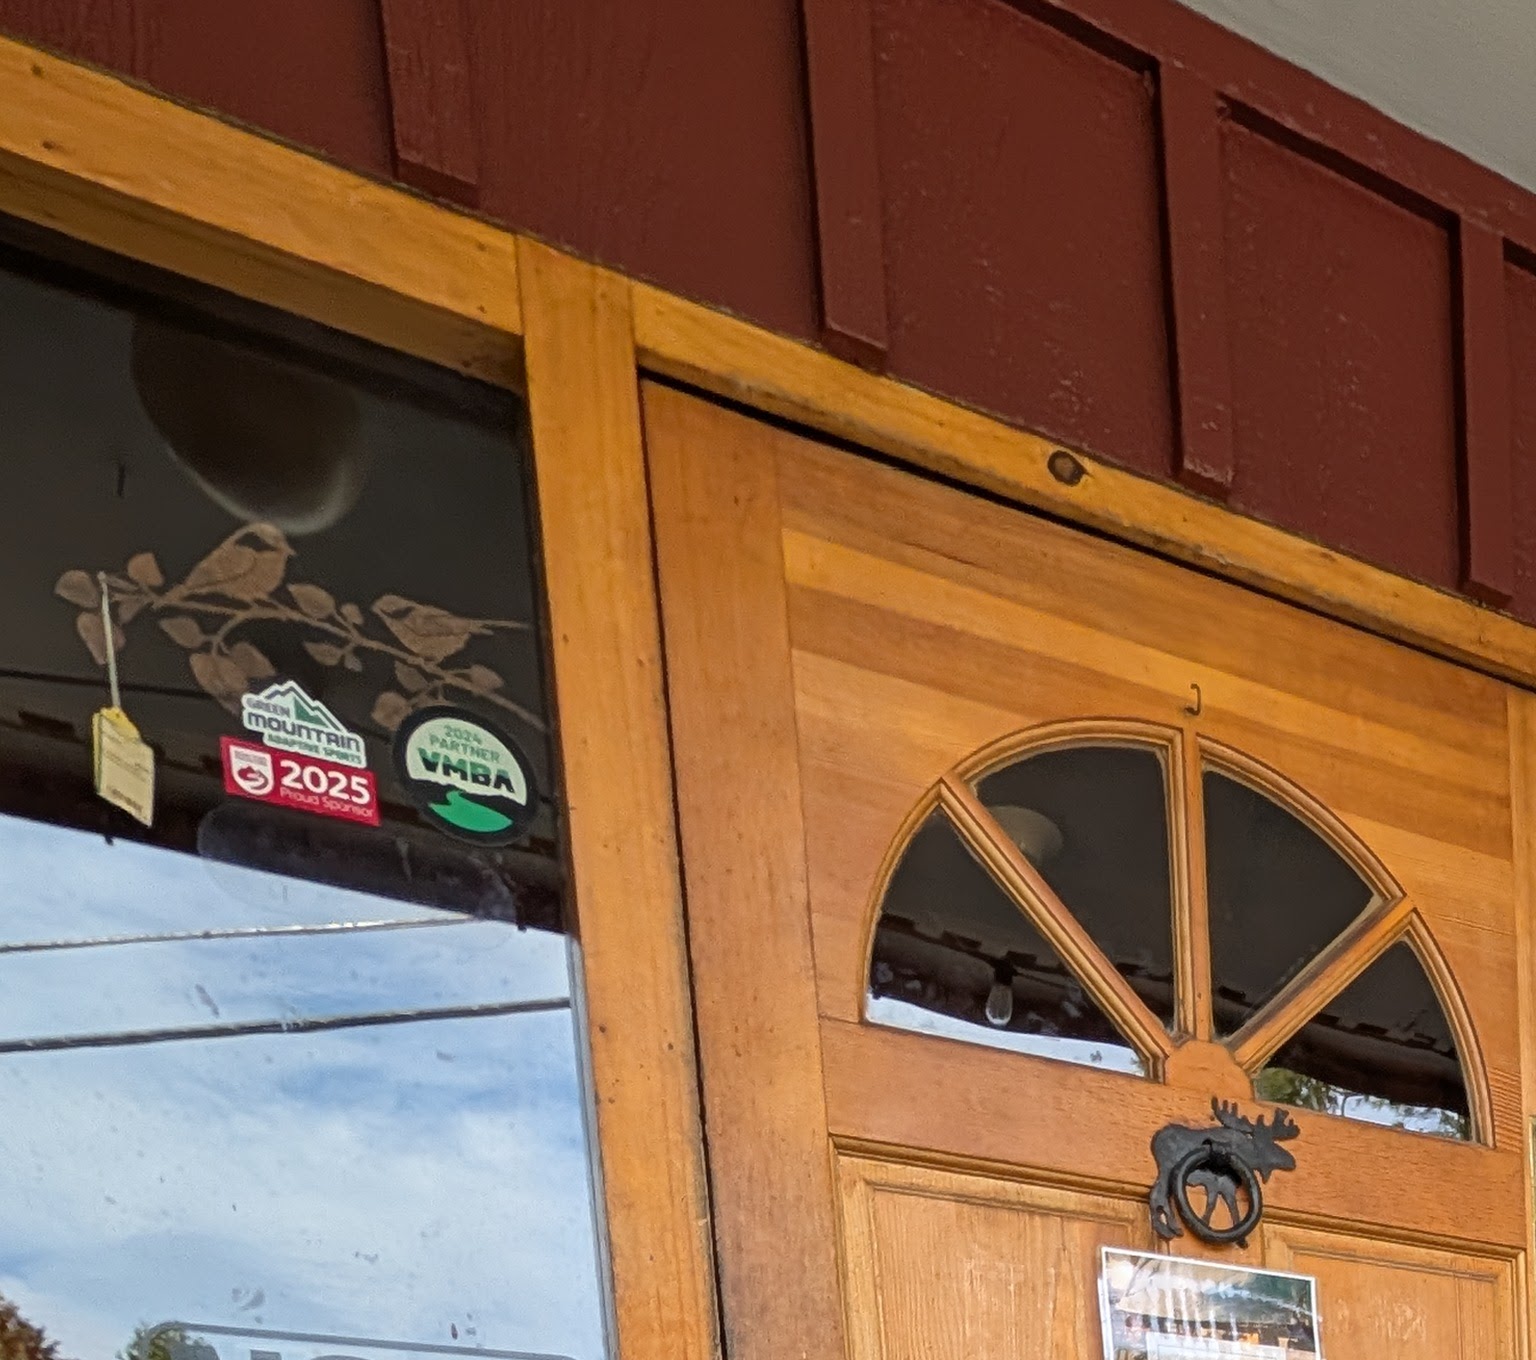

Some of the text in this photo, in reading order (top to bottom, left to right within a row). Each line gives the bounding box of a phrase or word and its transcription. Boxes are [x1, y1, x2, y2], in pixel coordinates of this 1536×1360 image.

[246, 697, 290, 718] GREEN
[248, 712, 360, 752] MOUNTAIN
[429, 734, 500, 763] PARTNER
[280, 760, 370, 805] 2025
[418, 747, 516, 794] VMBA
[280, 787, 373, 817] Proud Sponsor
